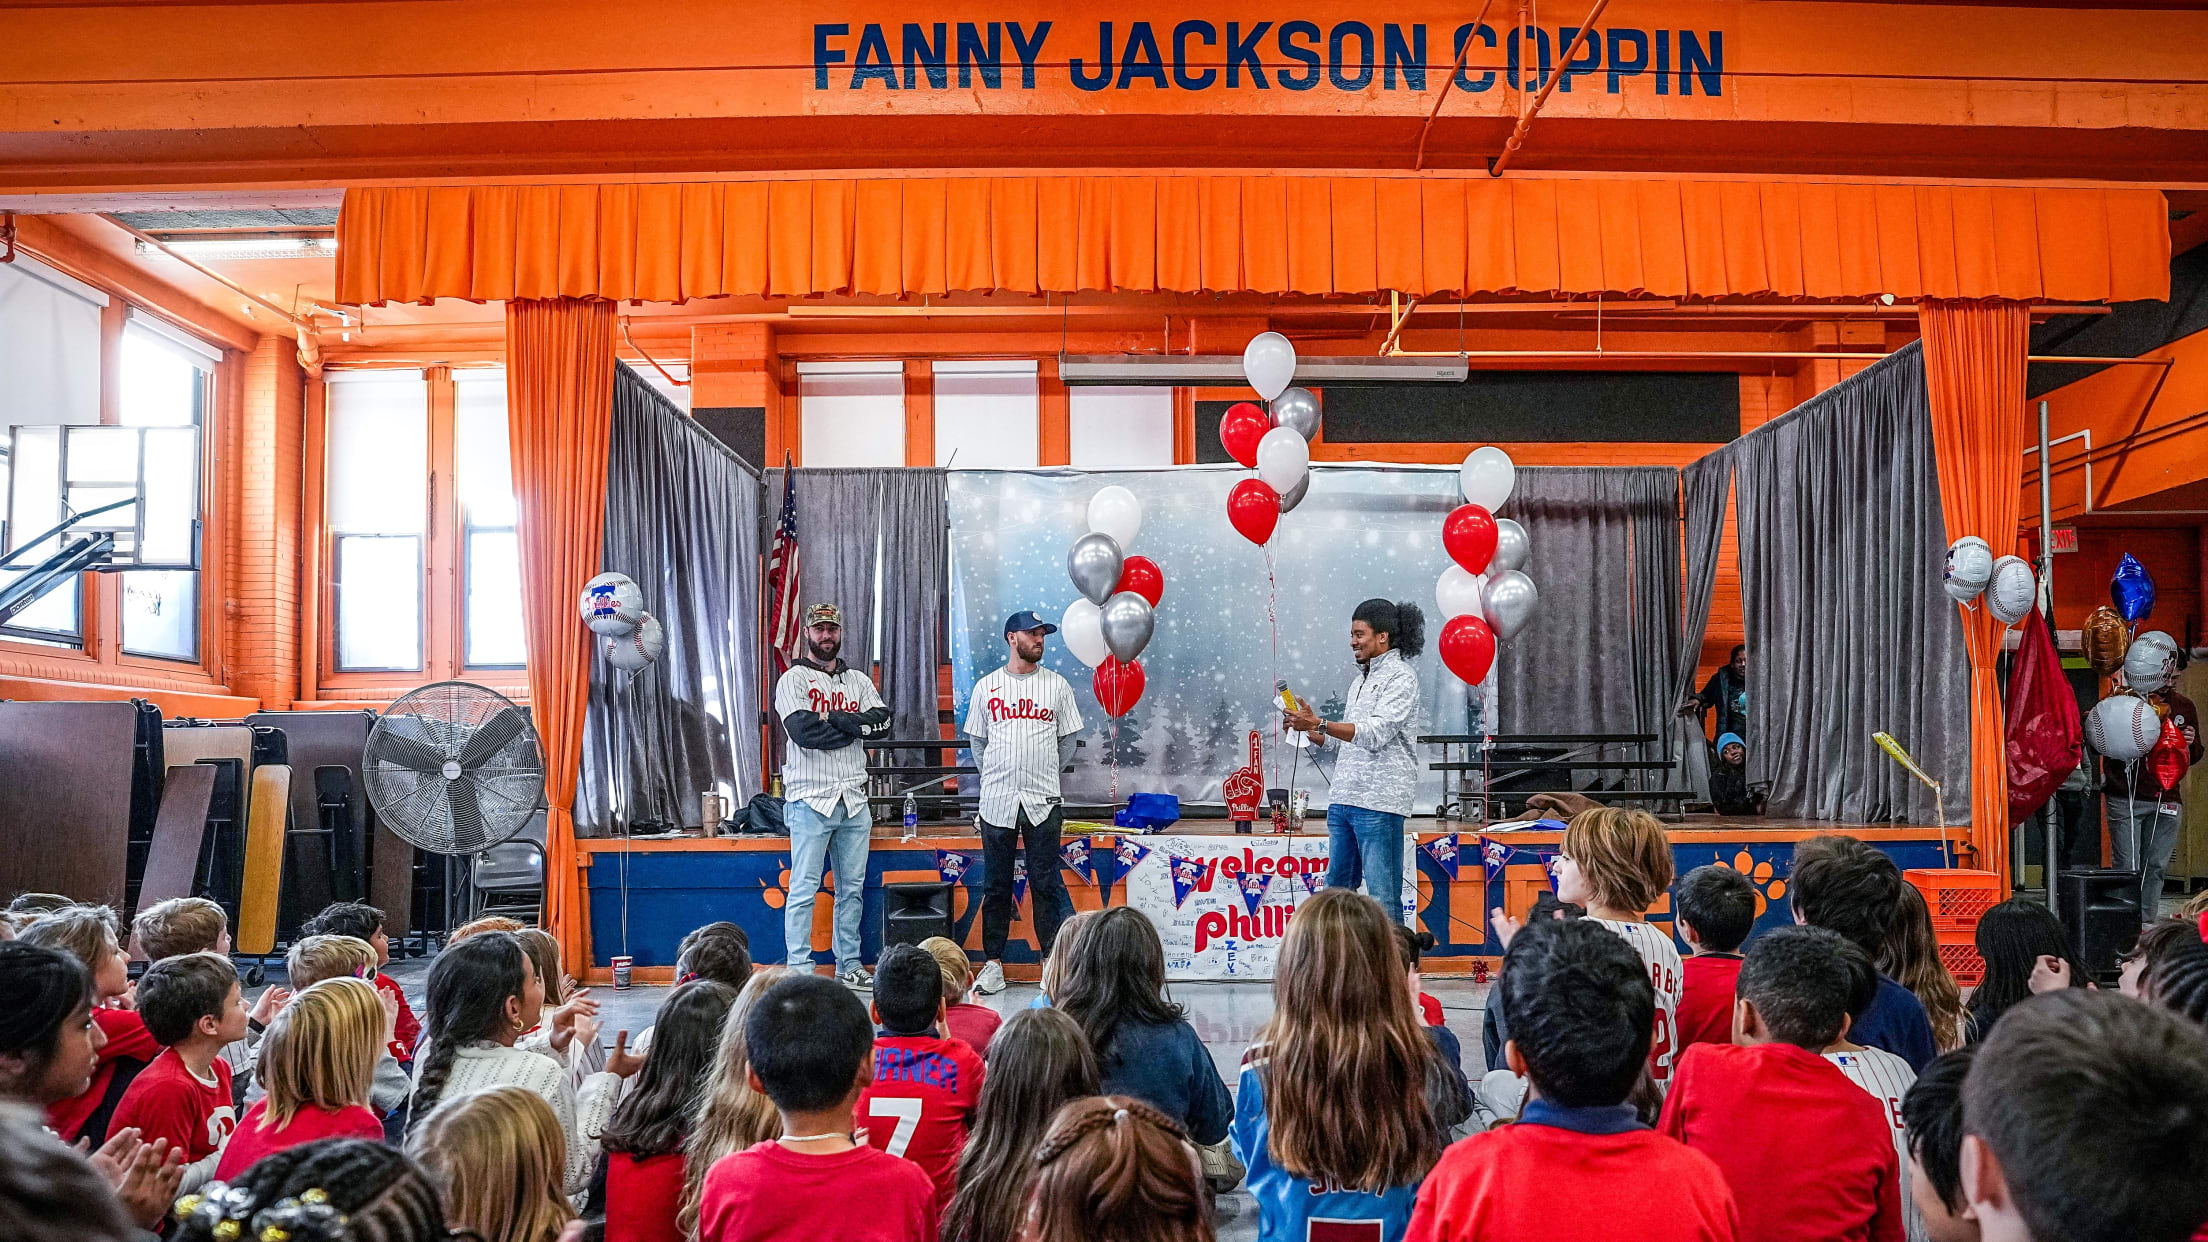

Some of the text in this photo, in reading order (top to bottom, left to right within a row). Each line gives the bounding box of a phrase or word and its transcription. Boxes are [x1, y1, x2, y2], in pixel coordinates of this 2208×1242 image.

[813, 19, 1723, 96] FANNY JACKSON COPPIN
[987, 697, 1055, 722] Phillies
[1231, 803, 1255, 812] Phillies
[874, 1047, 958, 1094] RNER
[869, 1097, 923, 1159] 7
